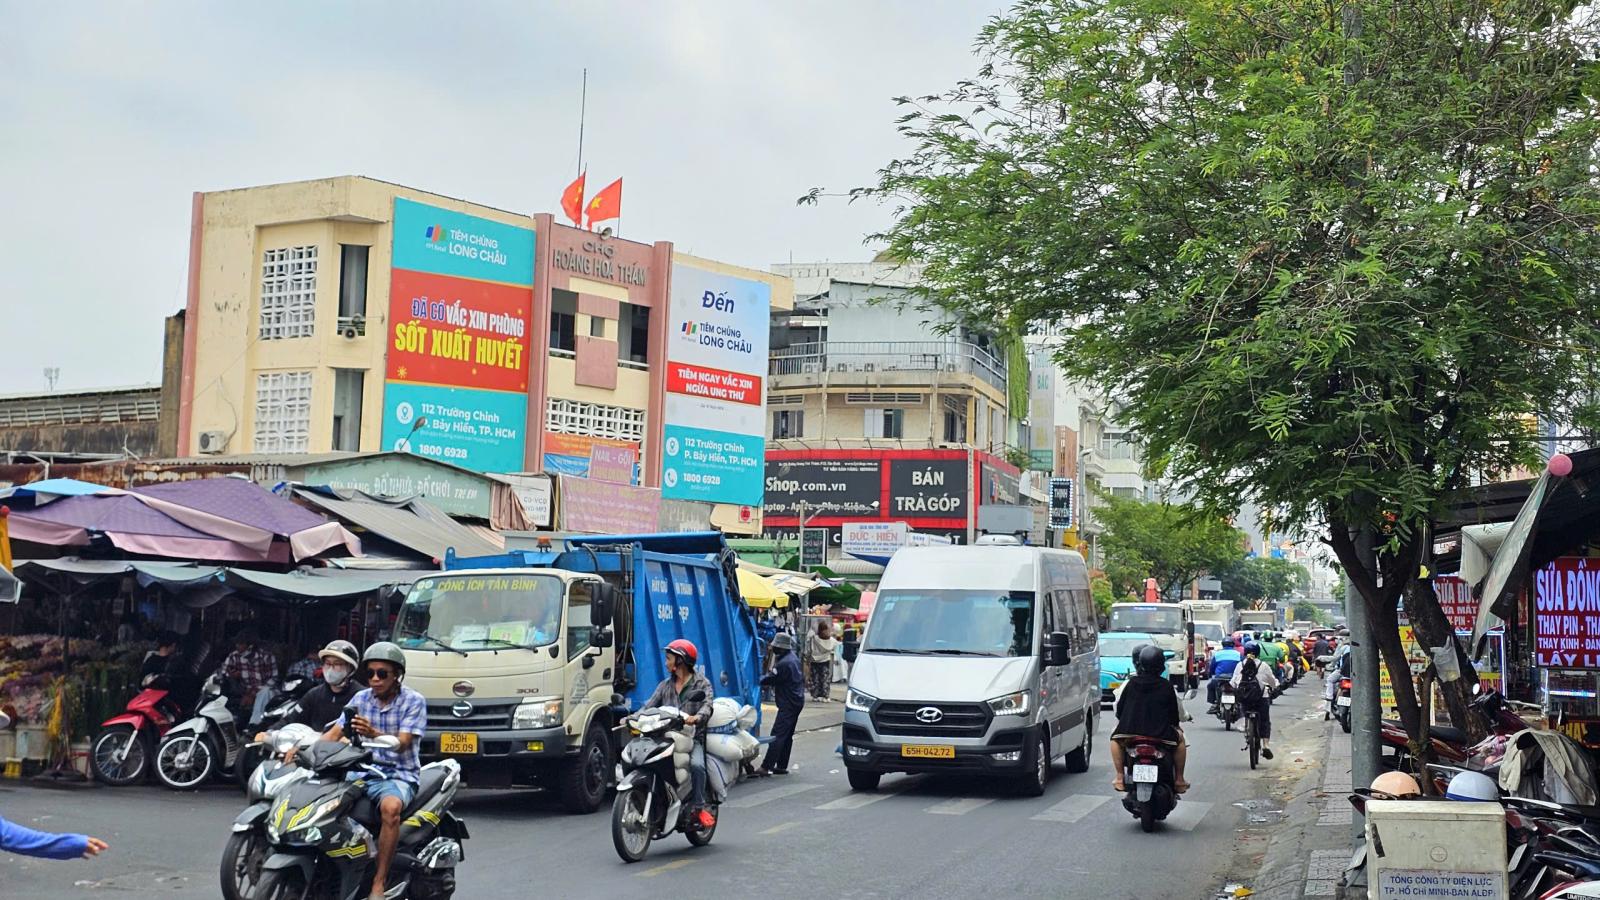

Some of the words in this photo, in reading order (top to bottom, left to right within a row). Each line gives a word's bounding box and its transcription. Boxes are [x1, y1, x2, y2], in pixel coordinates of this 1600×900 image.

[450, 229, 468, 242] TIÊM
[449, 242, 478, 259] LONG
[479, 249, 507, 266] CHÂU
[582, 240, 615, 259] CHỢ
[552, 247, 590, 275] HOÀNG
[592, 258, 614, 280] HOA
[617, 261, 647, 287] THÁM
[702, 290, 735, 314] Đến
[412, 296, 428, 320] ĐÃ
[430, 299, 445, 321] CÓ
[445, 299, 468, 327] VẮC
[468, 310, 488, 331] XIN
[489, 312, 525, 338] PHÒNG
[700, 322, 715, 333] TIÊM
[394, 319, 428, 355] SỐT
[430, 327, 473, 362] XUẤT
[475, 337, 524, 370] HUYẾT
[699, 334, 725, 348] LONG
[726, 338, 752, 353] CHÂU
[678, 367, 697, 380] TIÊM
[698, 373, 720, 384] NGAY
[721, 373, 738, 387] VẮC
[739, 379, 753, 390] XIN
[685, 381, 709, 395] NGỪA
[710, 387, 727, 398] UNG
[728, 390, 745, 401] THƯ
[421, 403, 435, 415] 112
[436, 404, 471, 421] Trường
[473, 409, 500, 424] Chinh
[479, 425, 493, 437] TP.
[494, 428, 516, 440] HCM
[419, 443, 442, 456] 1800
[443, 446, 468, 459] 6928
[684, 437, 695, 447] 112
[696, 438, 722, 452] Trường
[723, 442, 745, 453] Chinh
[684, 450, 692, 459] P.
[728, 455, 740, 465] TP.
[740, 457, 757, 467] HCM
[683, 472, 701, 483] 1800
[702, 474, 721, 486] 6928
[912, 466, 944, 486] BÁN
[431, 479, 451, 498] CHƠI
[763, 501, 786, 512] aptop
[895, 491, 926, 512] TRẢ
[927, 492, 961, 512] GÓP
[437, 576, 465, 592] CÔNG
[467, 576, 486, 592] ÍCH
[487, 575, 508, 592] TÂN
[511, 576, 538, 592] BÌNH
[1435, 577, 1455, 604] SỬA
[1536, 561, 1564, 612] SỬA
[657, 603, 673, 623] SẠCH
[1454, 615, 1466, 626] PIN
[1537, 614, 1562, 635] THAY
[1563, 615, 1579, 636] PIN
[1537, 637, 1559, 650] THAY
[1560, 634, 1580, 650] KÍNH
[1538, 649, 1578, 667] LẤY
[444, 743, 474, 752] 205.09
[450, 734, 467, 743] 50H
[906, 747, 951, 756] 65H-042.72
[1390, 874, 1413, 885] TỔNG
[1415, 874, 1439, 885] CÔNG
[1441, 876, 1451, 885] TY
[1452, 875, 1473, 886] ĐIỆN
[1475, 876, 1493, 887] LỰC
[1384, 886, 1397, 895] TP.
[1399, 885, 1411, 895] HỒ
